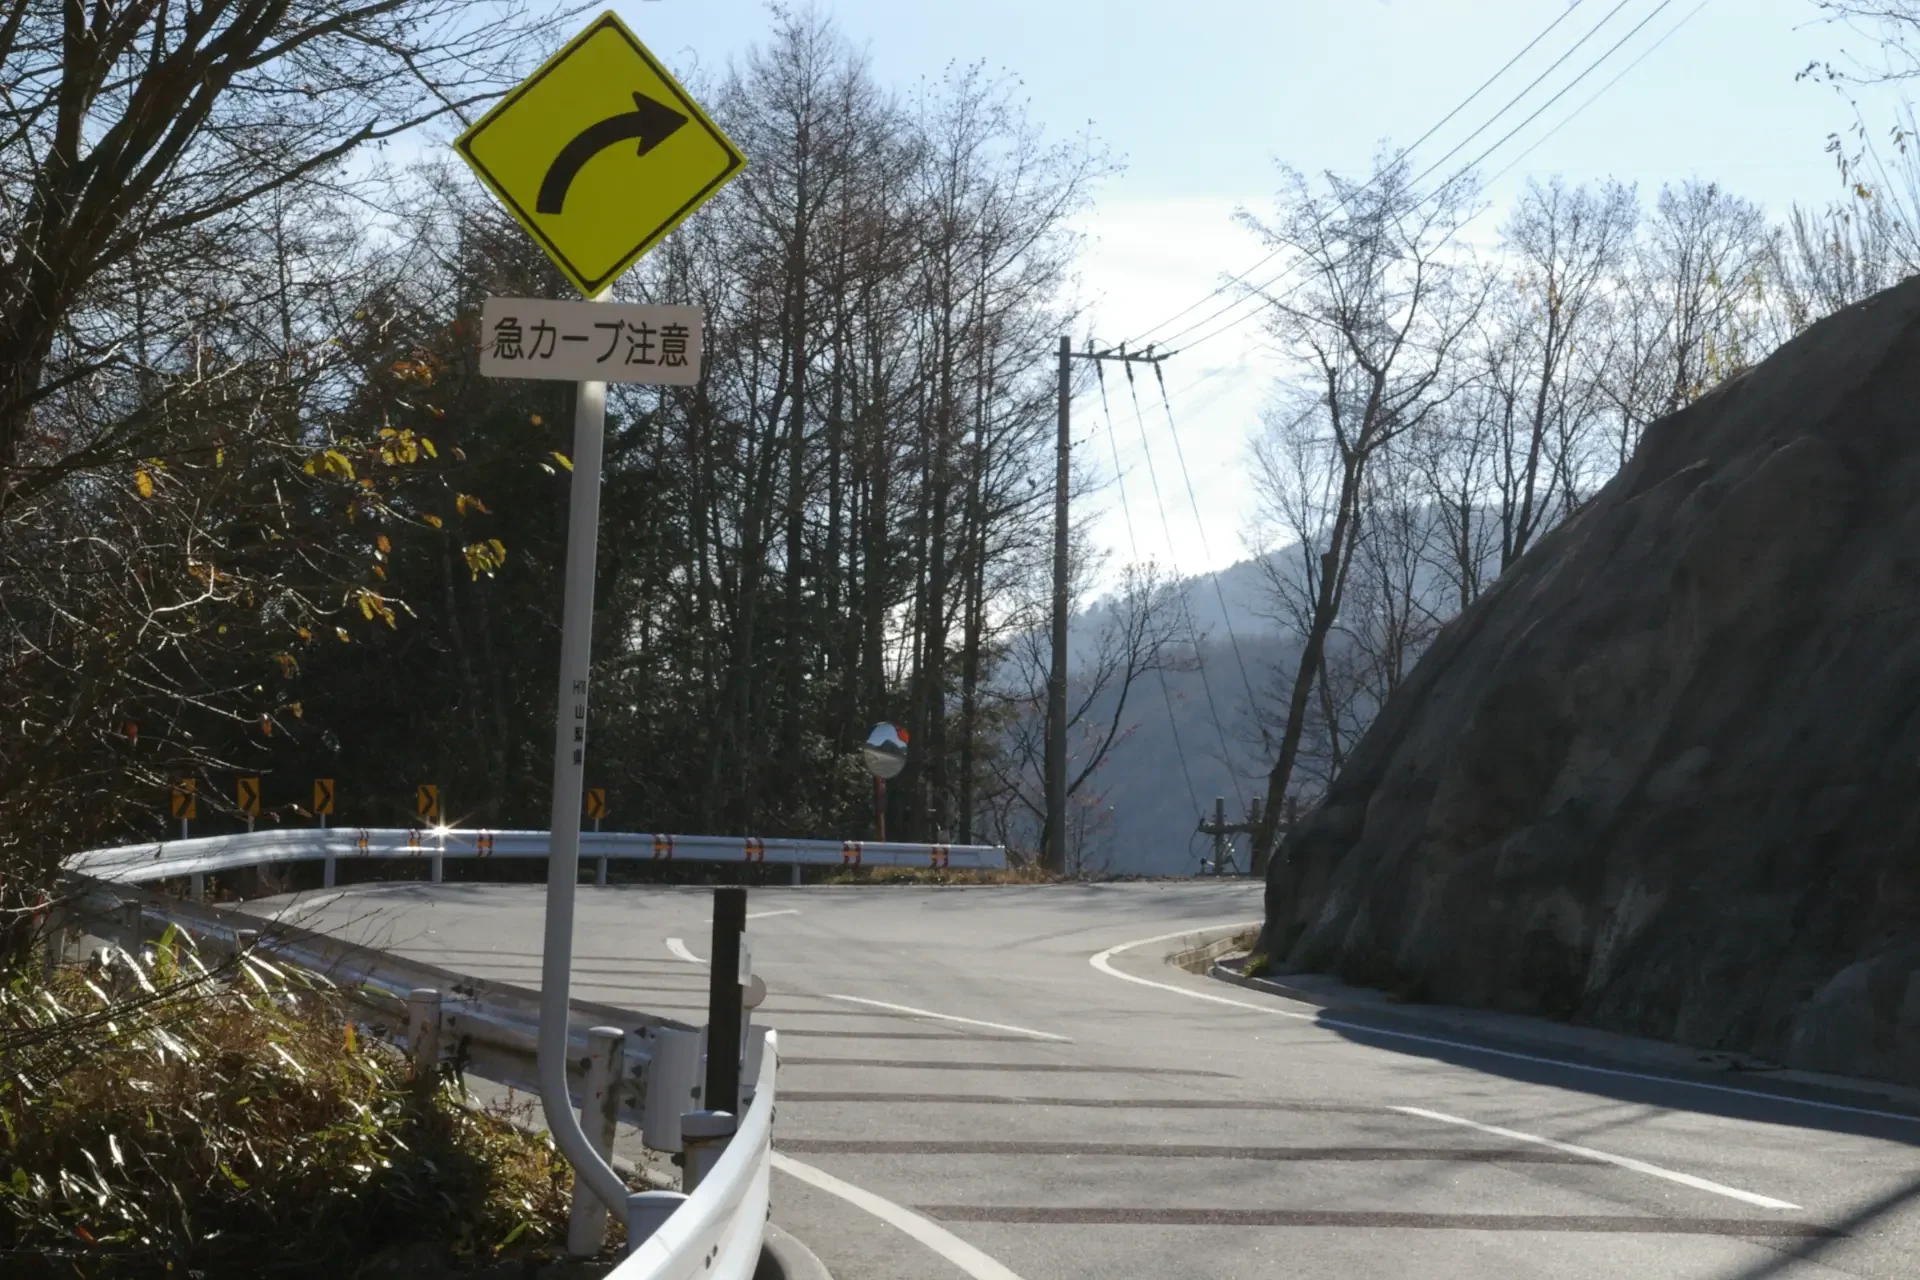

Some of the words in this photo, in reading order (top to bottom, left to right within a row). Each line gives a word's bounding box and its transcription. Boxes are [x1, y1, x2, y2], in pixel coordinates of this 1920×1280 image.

[493, 317, 690, 367] 急カーブ注意
